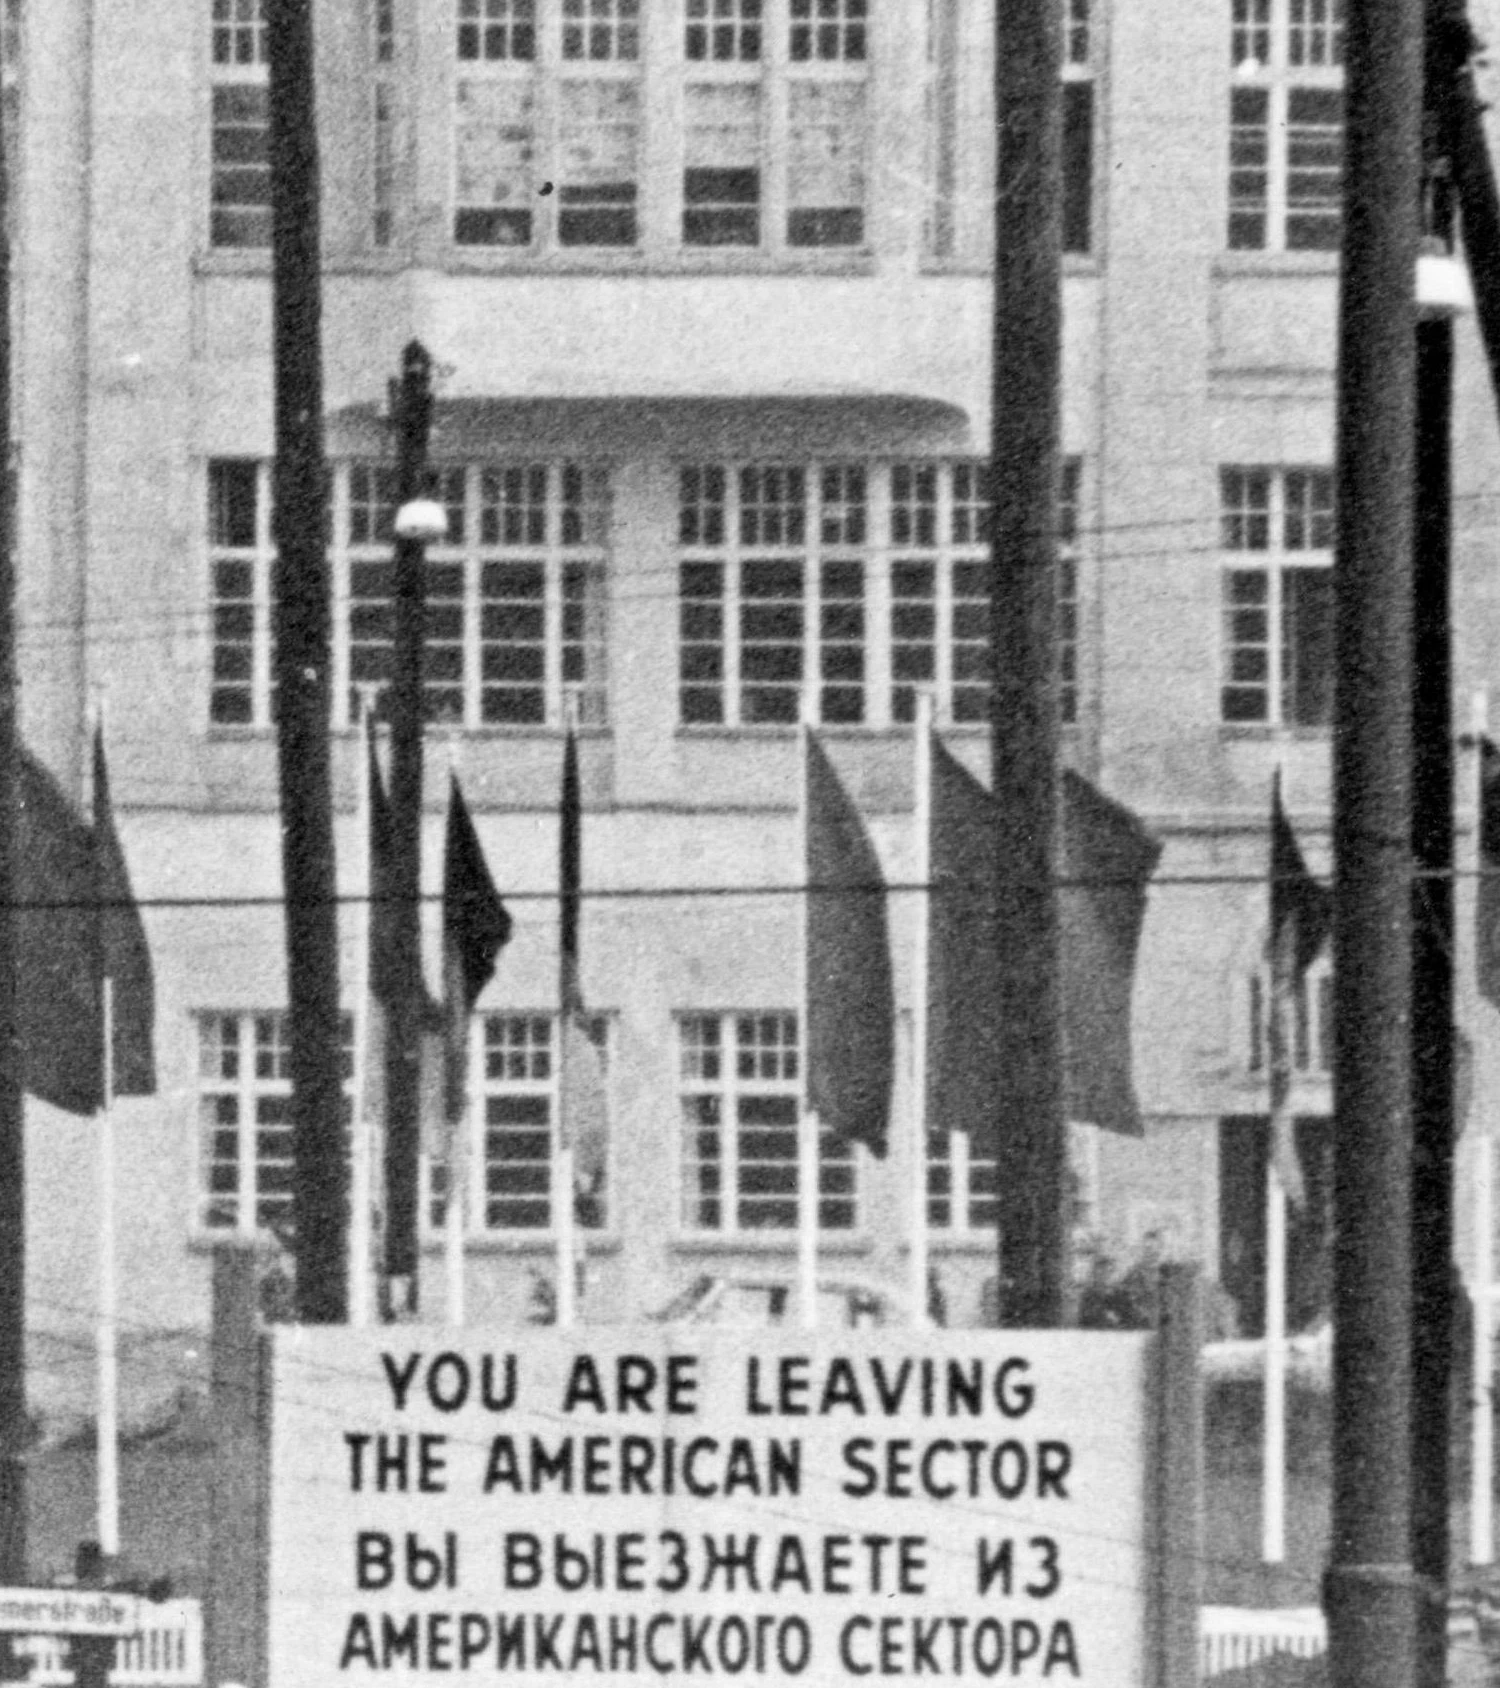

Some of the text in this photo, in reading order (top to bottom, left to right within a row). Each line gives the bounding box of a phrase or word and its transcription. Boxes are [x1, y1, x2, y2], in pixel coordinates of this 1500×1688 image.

[381, 1351, 1035, 1419] YOU ARE LEAVING
[344, 1432, 1072, 1501] THE AMERICAN SECTOR
[356, 1530, 1061, 1599] ВЫ ВЫЕЗЖАЕТЕ ИЗ
[340, 1612, 1079, 1677] АМЕРИКАНСКОГО СЕКТОРА
